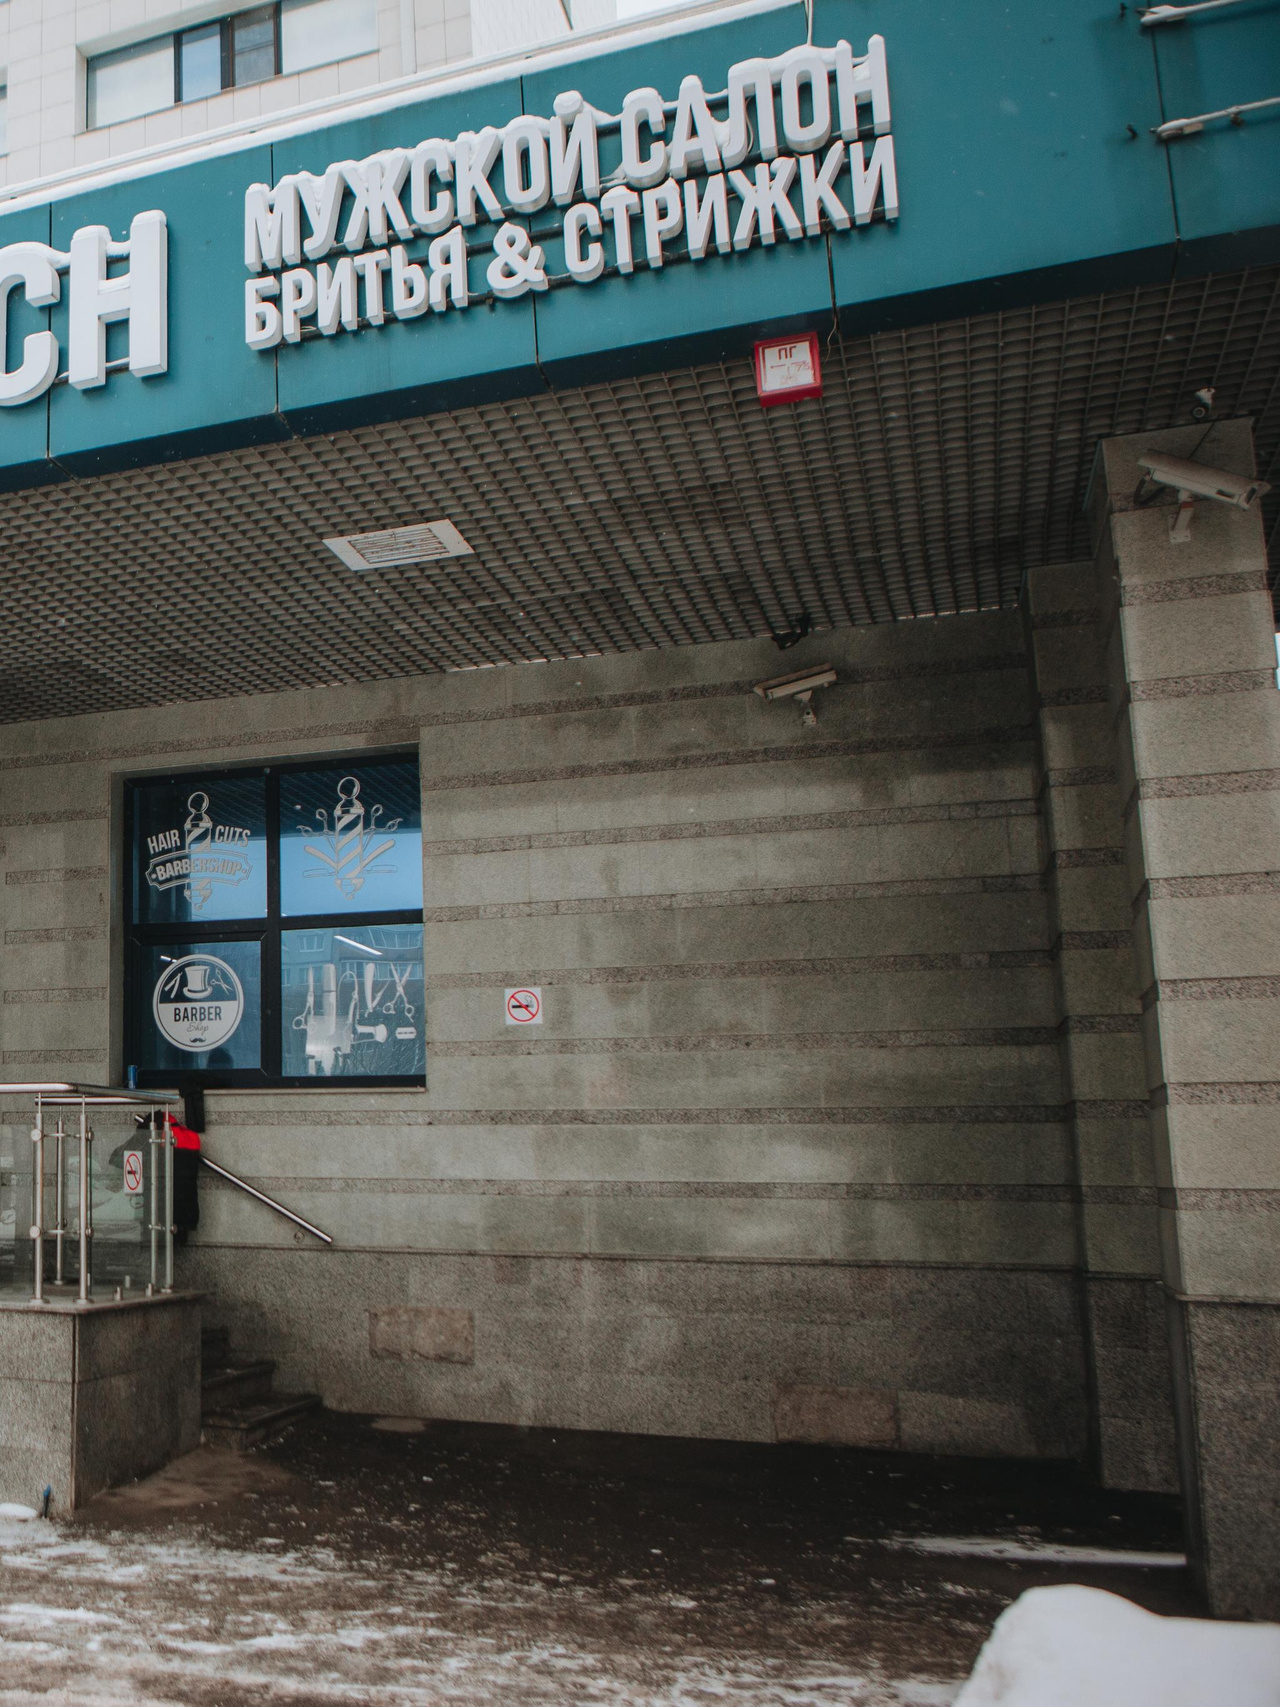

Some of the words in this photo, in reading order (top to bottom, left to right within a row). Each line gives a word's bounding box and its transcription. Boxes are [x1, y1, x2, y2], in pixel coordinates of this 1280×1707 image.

[244, 92, 600, 272] МУЖСКОЙ
[622, 35, 891, 189] САЛОН
[244, 225, 469, 351] БРИТЬЯ
[486, 222, 548, 299] &
[563, 135, 899, 283] СТРИЖКИ
[778, 345, 797, 360] ПГ
[147, 829, 181, 855] HAIR
[215, 825, 251, 848] CUTS
[155, 857, 243, 881] BARBERSHOP
[173, 1006, 222, 1022] BARBER
